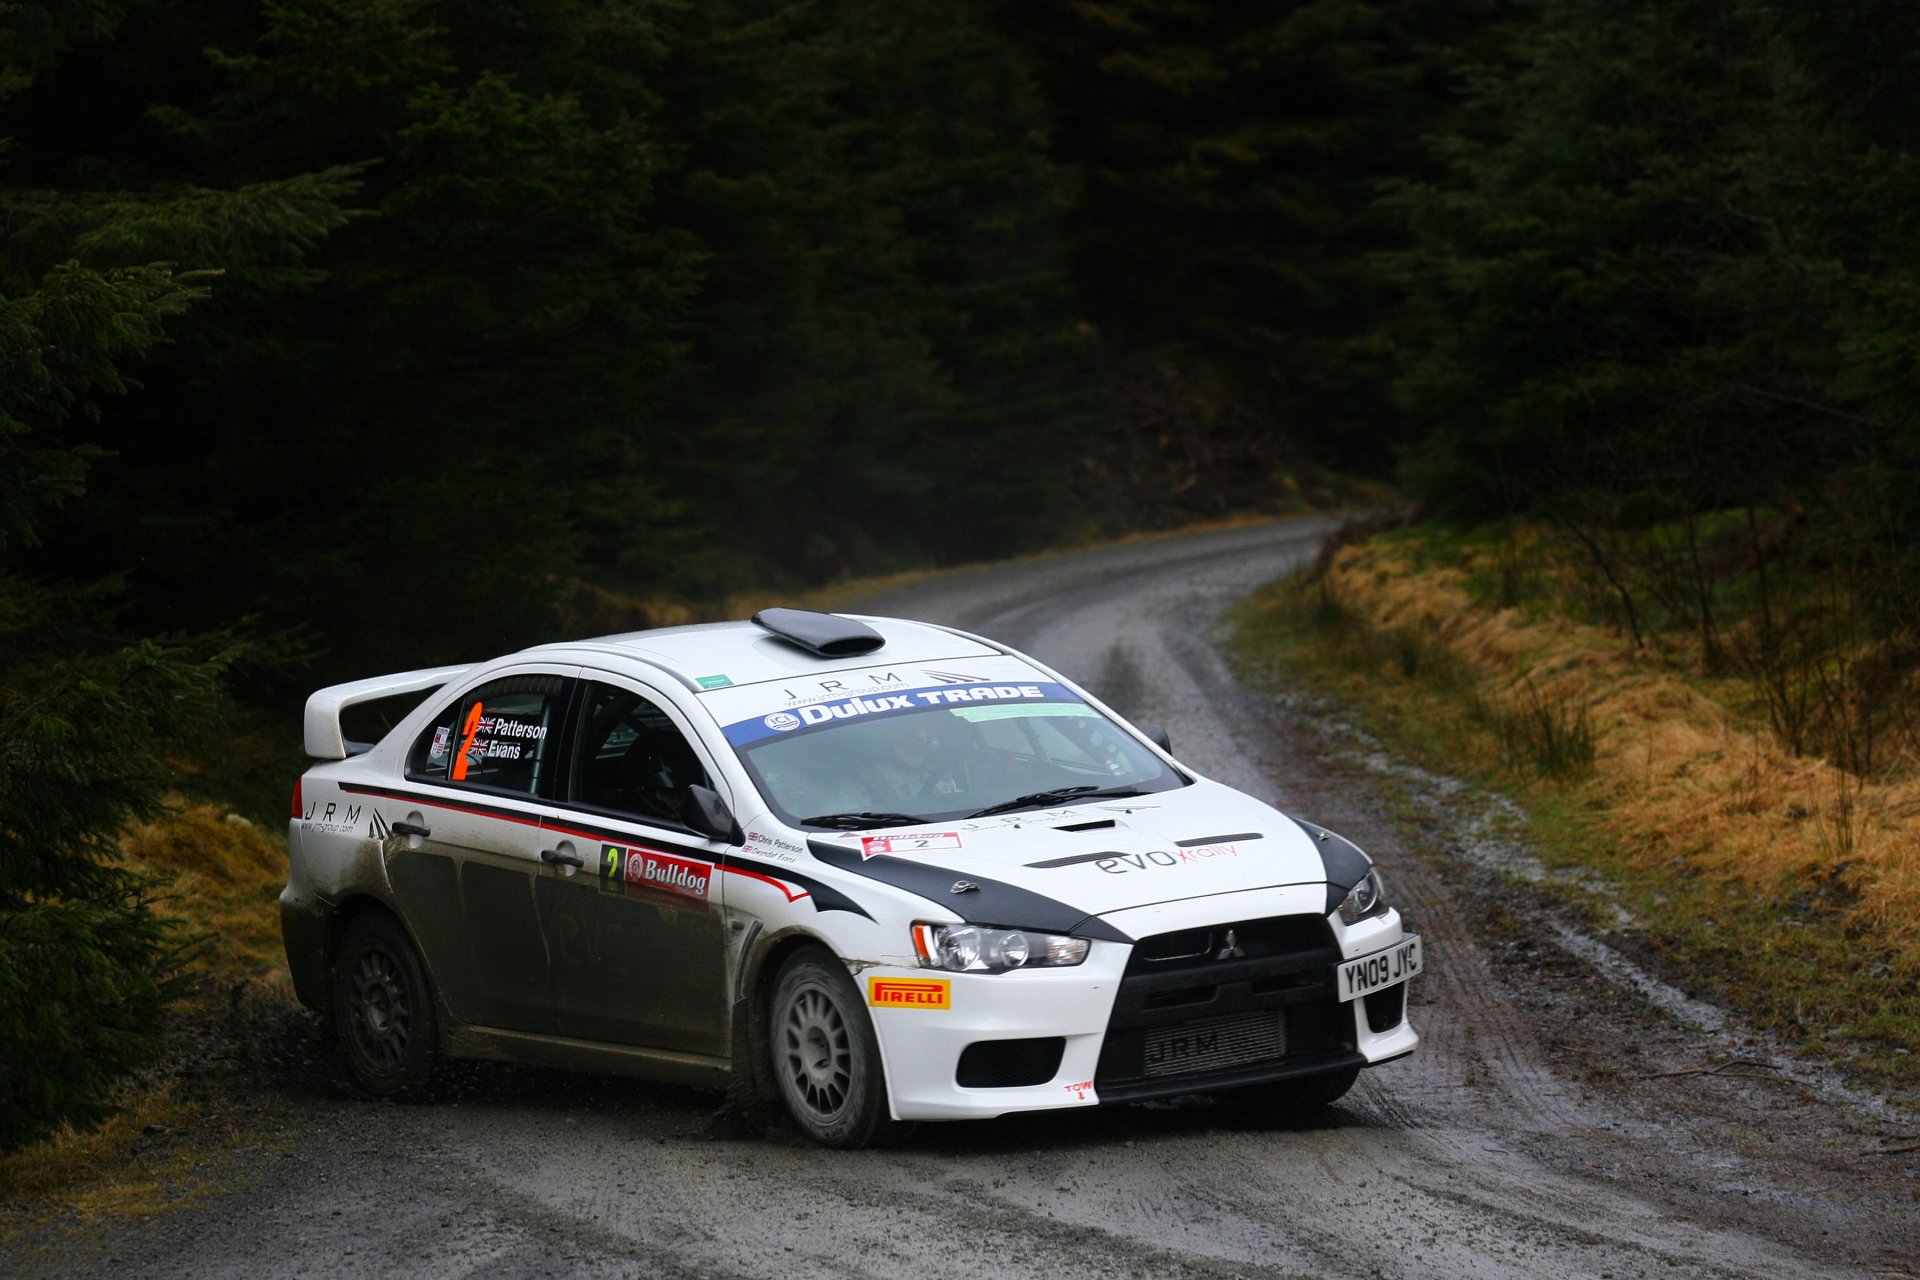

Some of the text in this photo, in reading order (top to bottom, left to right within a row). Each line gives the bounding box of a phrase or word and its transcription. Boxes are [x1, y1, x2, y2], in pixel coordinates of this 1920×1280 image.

[798, 686, 1044, 725] Dulux TRADE
[493, 718, 547, 740] Patterson
[487, 739, 521, 759] Evans
[774, 839, 803, 853] Patterson
[914, 840, 929, 848] 2
[607, 848, 618, 892] 2
[644, 859, 707, 895] Bulldog
[1345, 943, 1417, 993] YN09 JYC
[875, 982, 943, 1004] PIRELLI
[1151, 1032, 1218, 1062] JRM
[1064, 1080, 1092, 1093] TOW
